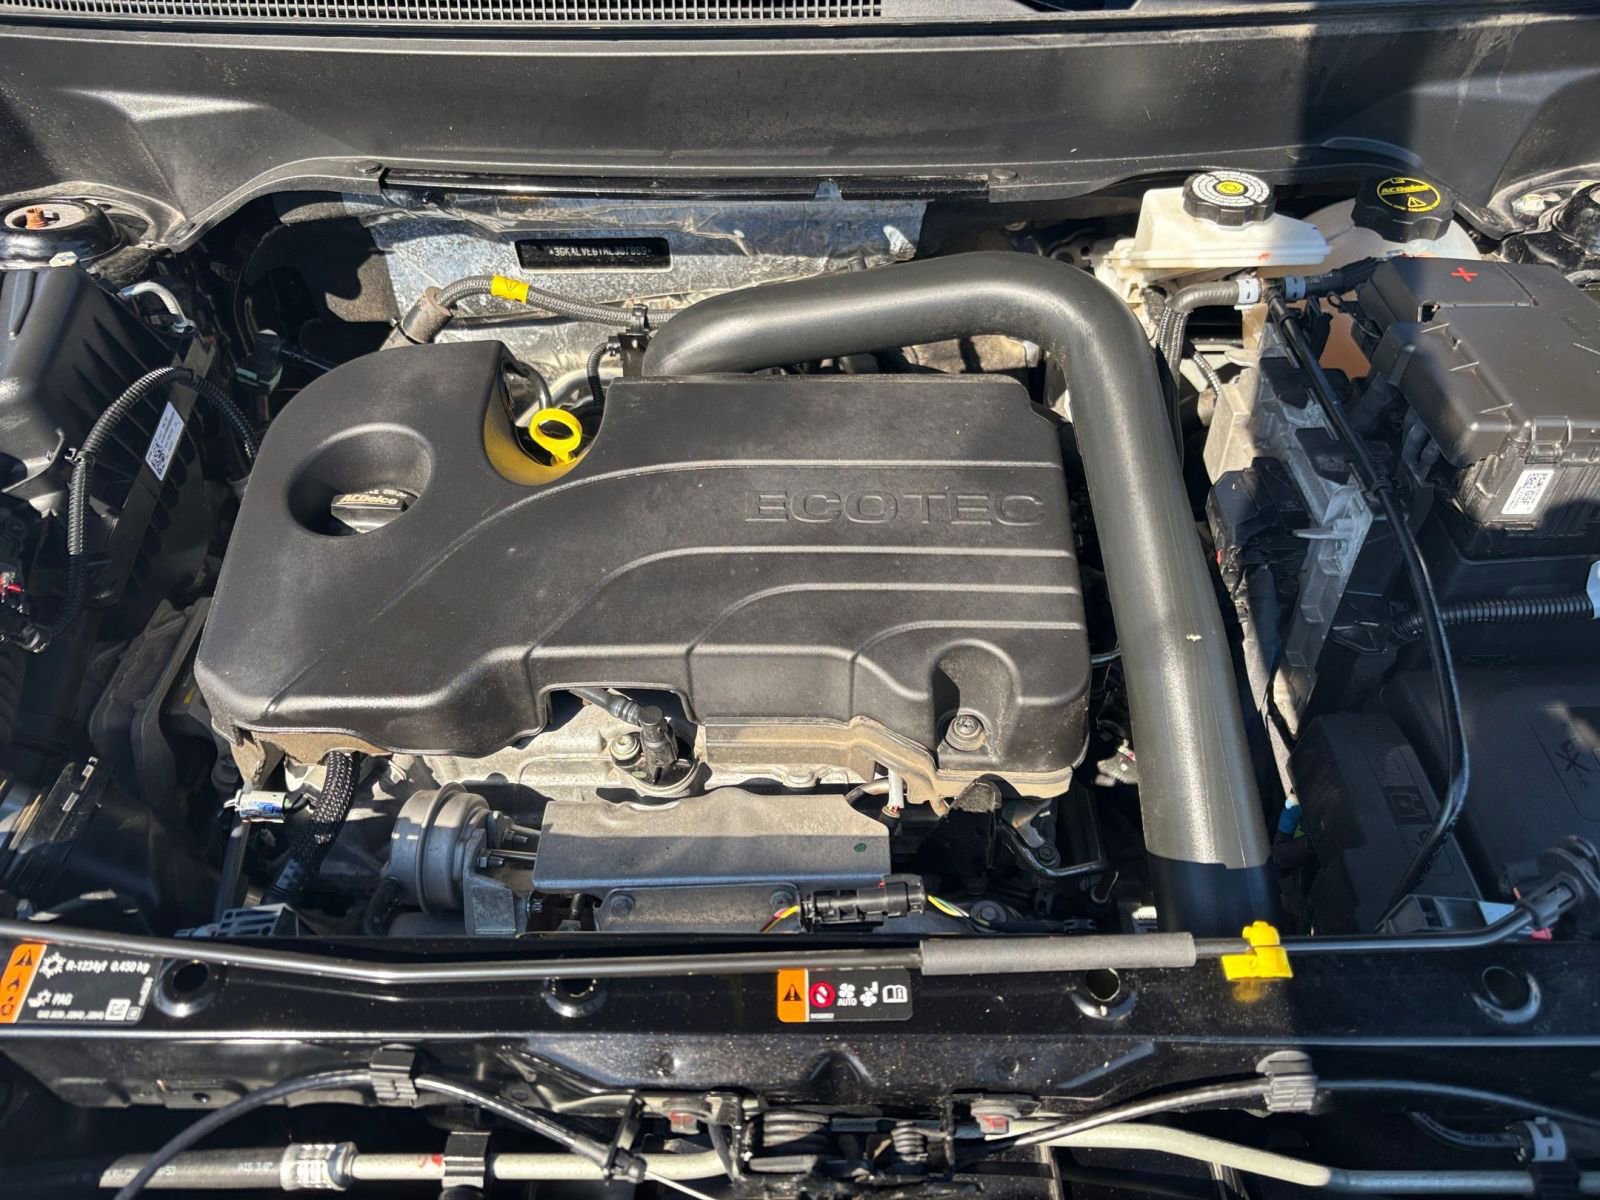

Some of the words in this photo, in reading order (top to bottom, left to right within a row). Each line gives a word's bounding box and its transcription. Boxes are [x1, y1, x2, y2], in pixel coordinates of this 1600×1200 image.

[339, 494, 399, 506] ACDelco
[744, 489, 1046, 528] ECOTEC
[836, 997, 858, 1007] AUTO
